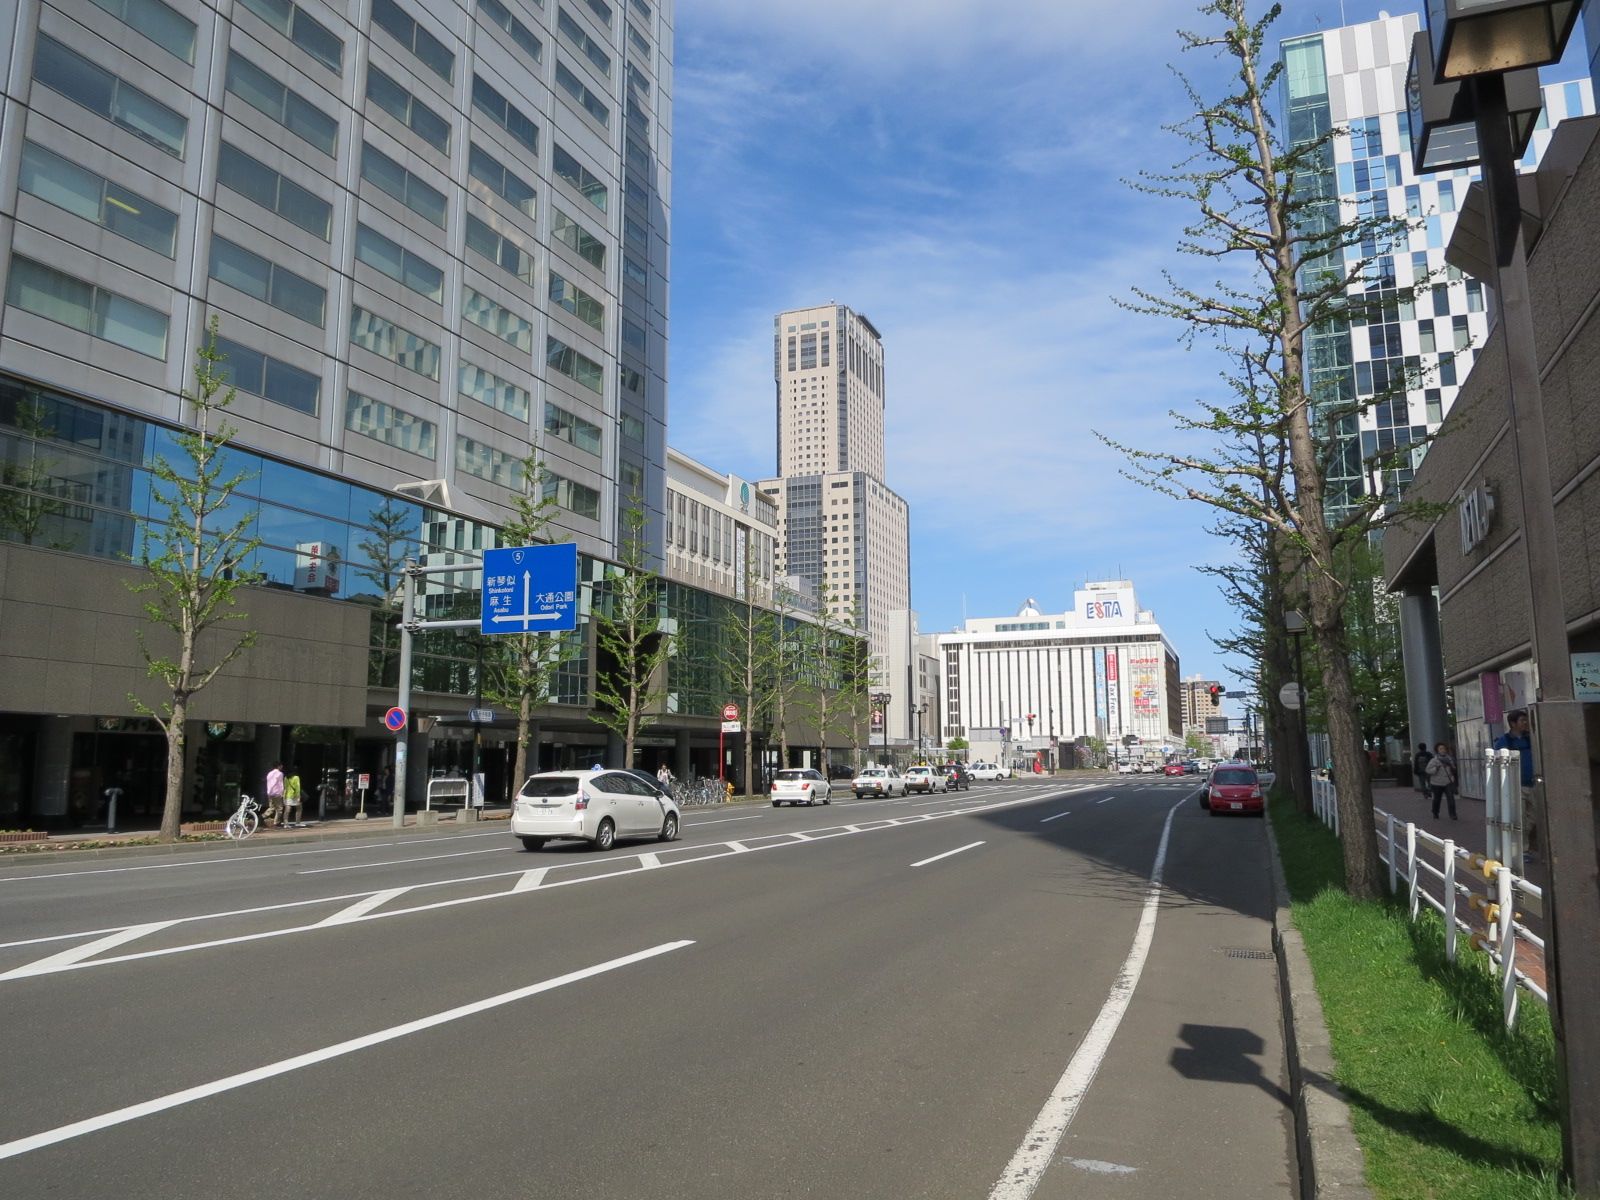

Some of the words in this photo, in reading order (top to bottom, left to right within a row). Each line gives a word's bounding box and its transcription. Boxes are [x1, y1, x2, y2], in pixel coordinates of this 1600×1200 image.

[487, 576, 516, 587] 新琴似
[489, 595, 512, 606] 麻生
[535, 591, 574, 603] 大通公園
[1086, 601, 1123, 619] ESTA
